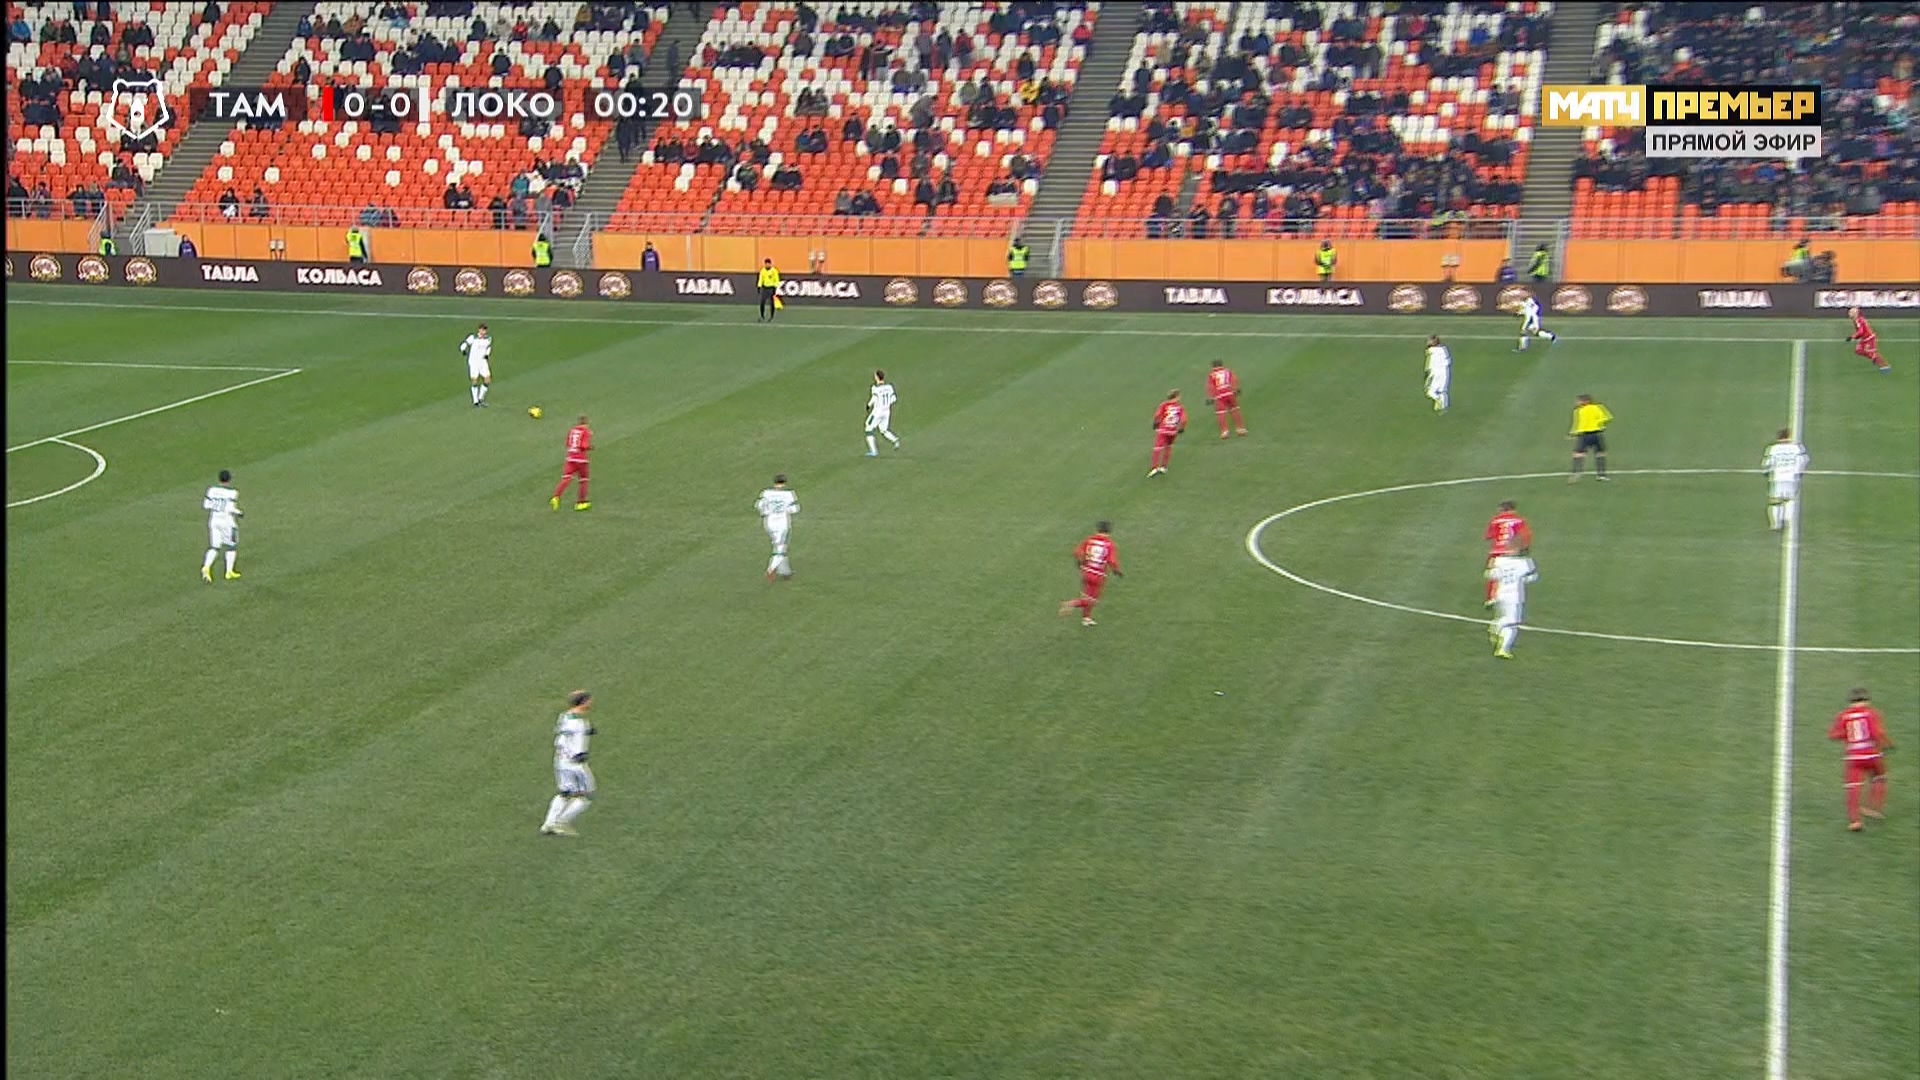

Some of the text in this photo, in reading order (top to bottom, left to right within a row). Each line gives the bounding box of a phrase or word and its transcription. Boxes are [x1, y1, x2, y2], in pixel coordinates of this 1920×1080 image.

[201, 264, 382, 286] ТАВЛА КОЛБАСА
[675, 278, 735, 295] ТАВЛА
